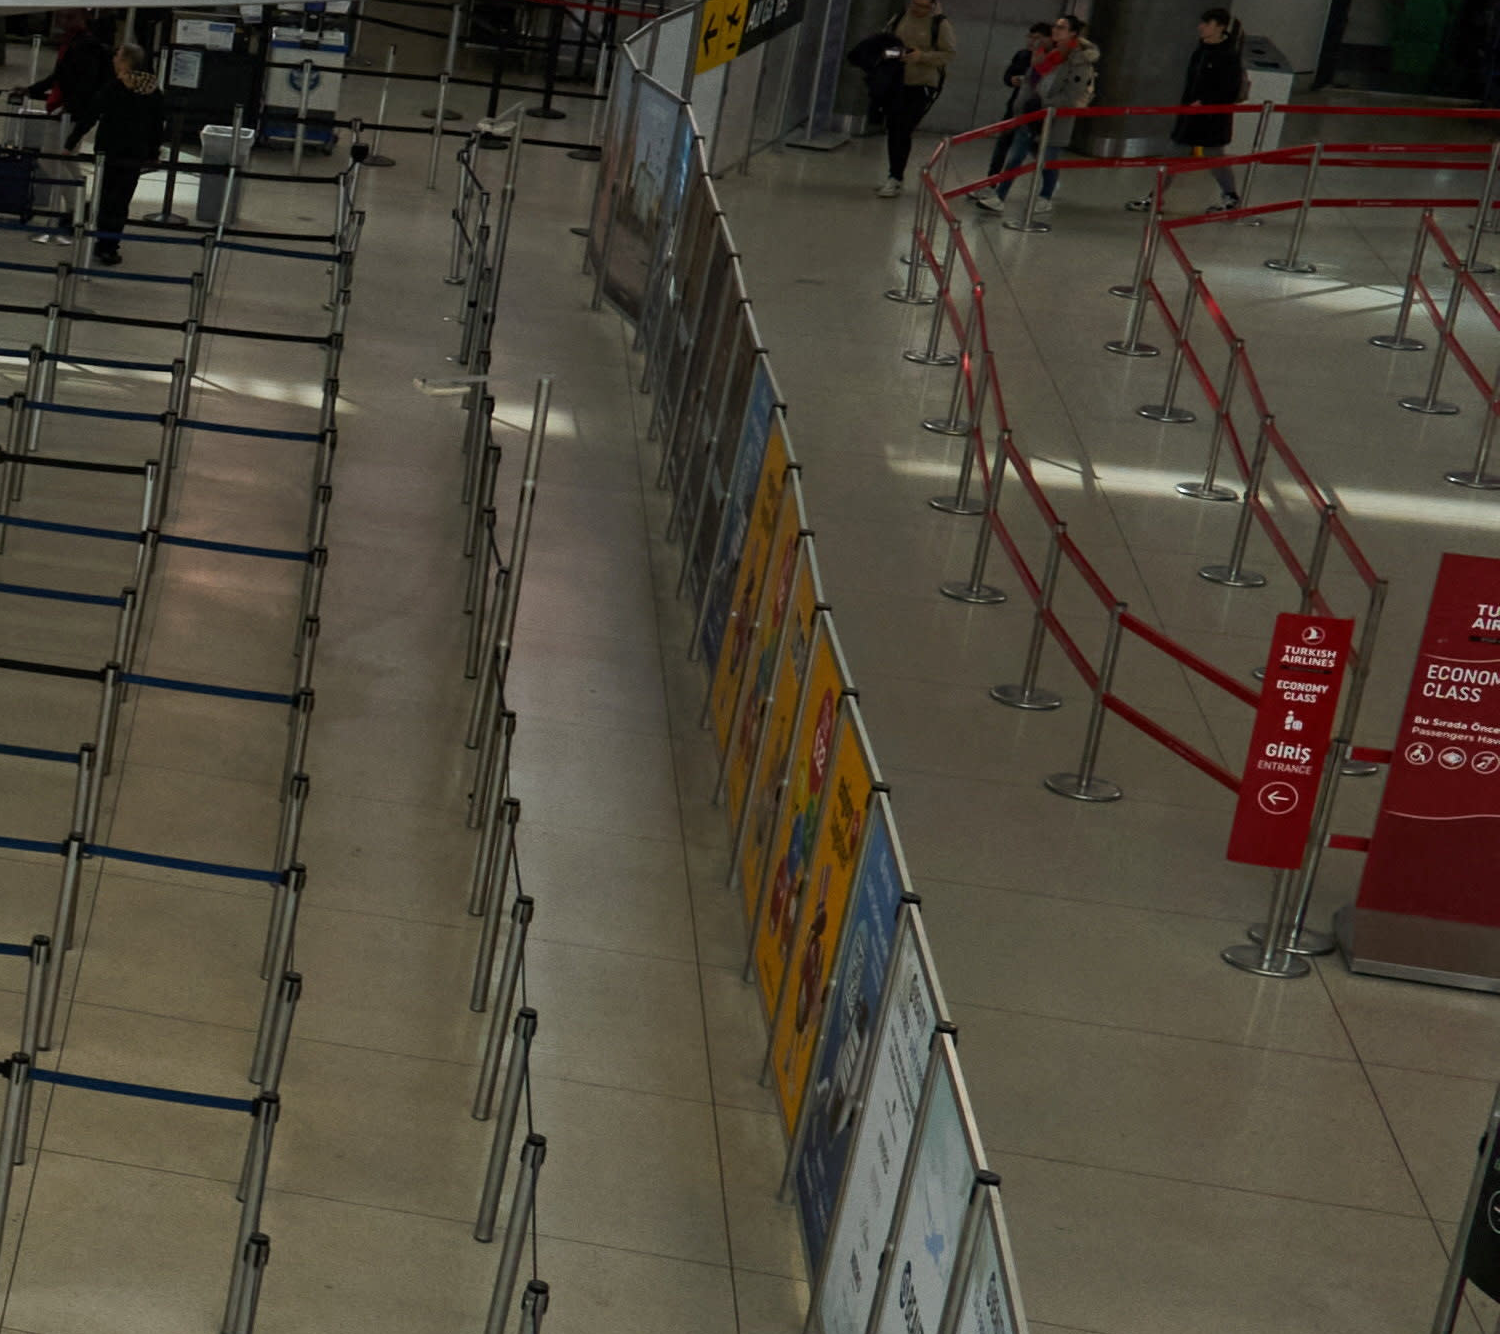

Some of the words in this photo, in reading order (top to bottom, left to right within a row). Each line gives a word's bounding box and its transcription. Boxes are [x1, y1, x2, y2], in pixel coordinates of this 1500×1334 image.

[1283, 644, 1337, 659] TURKISH
[1280, 653, 1336, 668] AIRLINES
[1276, 678, 1329, 694] ECONOMY
[1421, 682, 1483, 704] CLASS
[1283, 691, 1317, 704] CLASS
[1411, 726, 1476, 744] Passengers
[1256, 759, 1312, 776] ENTRANCE
